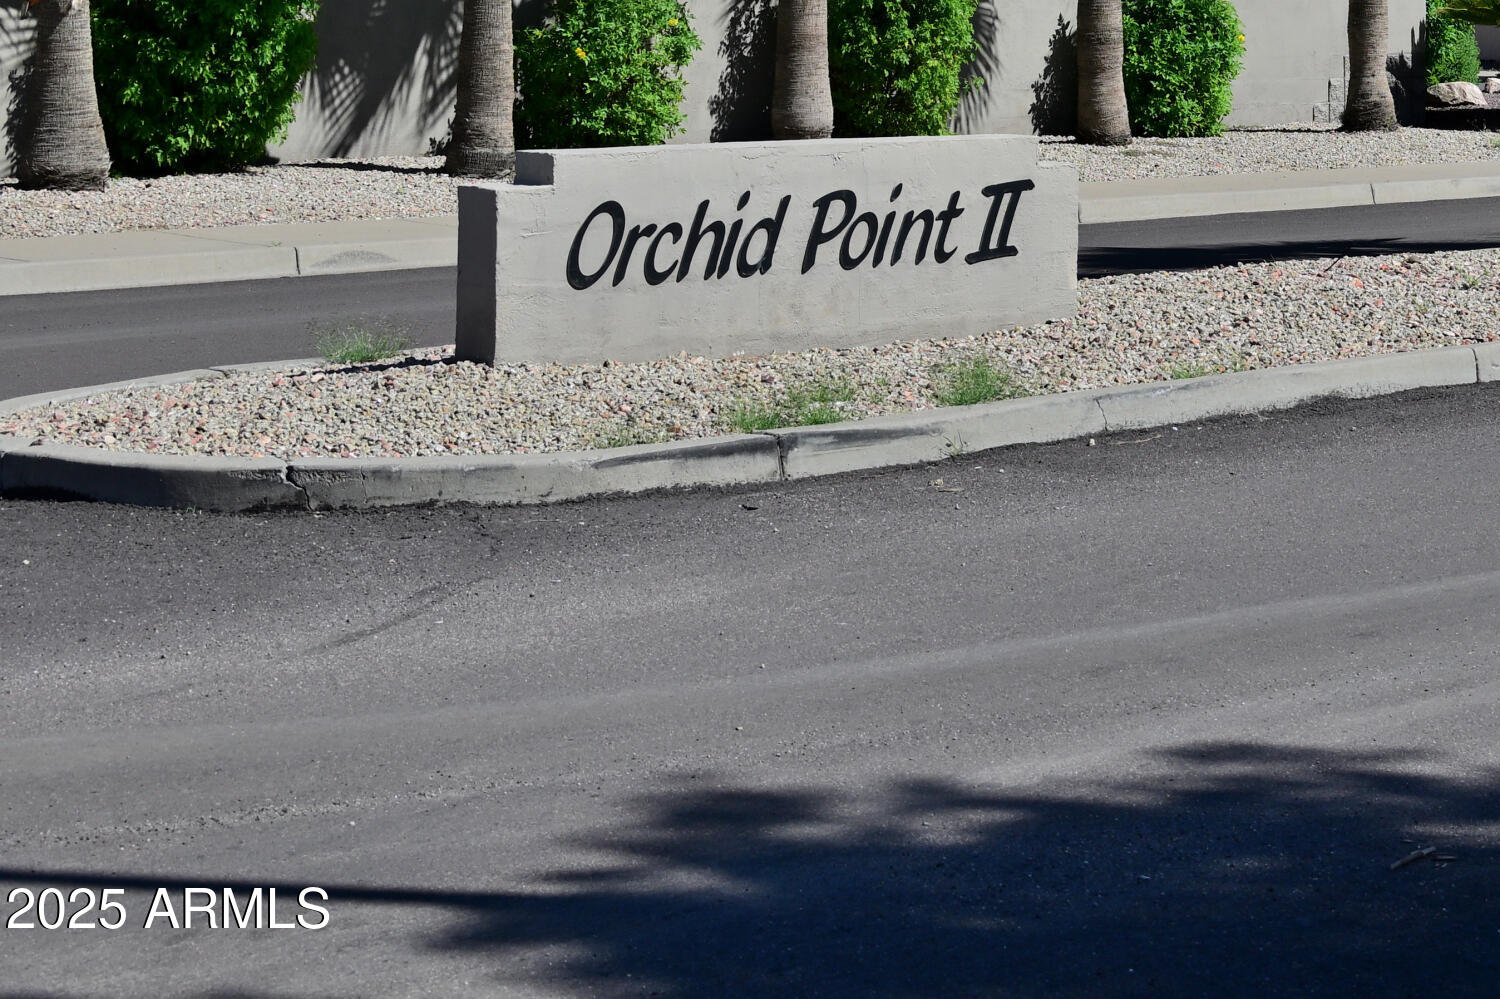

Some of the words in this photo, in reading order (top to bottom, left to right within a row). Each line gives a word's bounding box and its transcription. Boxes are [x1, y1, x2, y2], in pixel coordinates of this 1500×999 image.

[565, 190, 792, 291] Orchid
[800, 182, 965, 275] Point
[964, 178, 1036, 266] II
